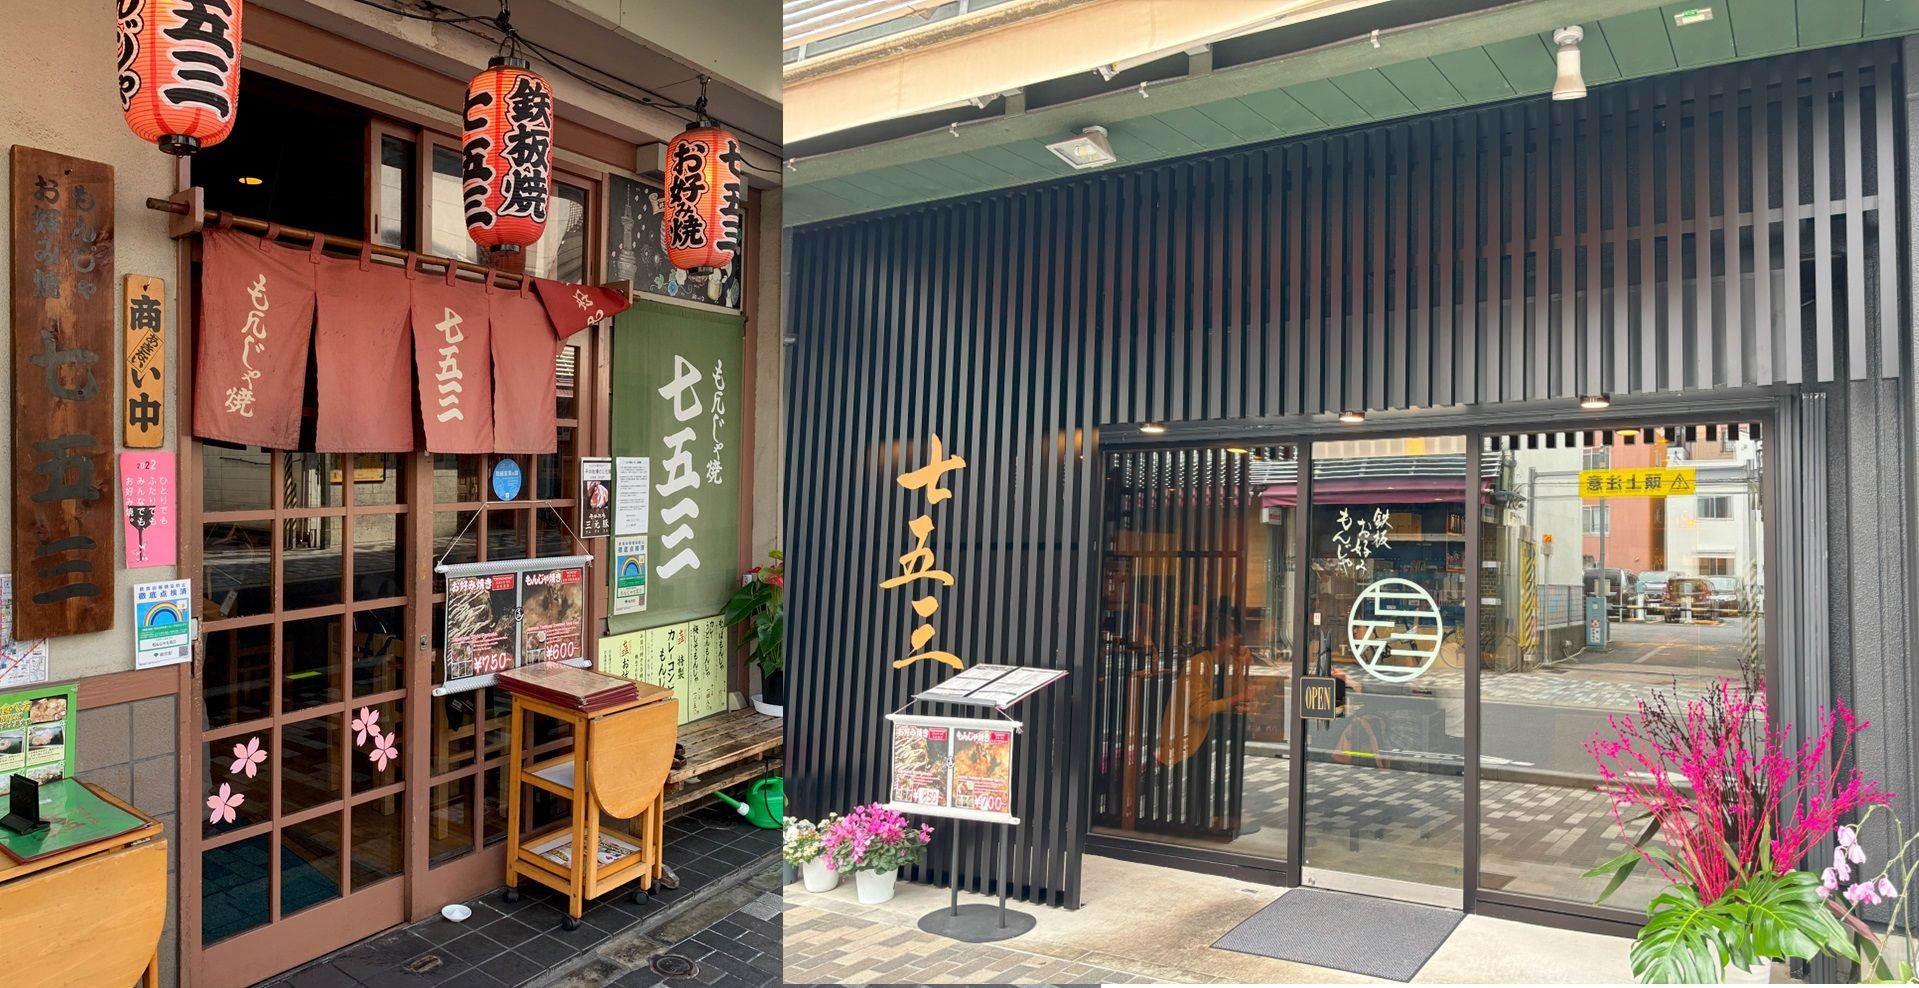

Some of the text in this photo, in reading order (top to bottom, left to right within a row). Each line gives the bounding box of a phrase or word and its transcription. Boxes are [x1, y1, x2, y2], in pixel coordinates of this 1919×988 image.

[502, 79, 549, 219] 鉄板焼
[669, 143, 705, 247] お好み焼
[718, 140, 740, 251] 七五三
[224, 273, 270, 418] もんじゃ焼
[434, 306, 465, 423] 七五三
[706, 359, 726, 485] もんじゃ焼
[30, 327, 99, 604] 七五三
[137, 459, 156, 470] 2022
[656, 354, 703, 580] 七五三
[159, 476, 169, 526] ひとりでも
[1373, 507, 1394, 549] 鉄板
[879, 432, 967, 671] 七五三
[1351, 518, 1373, 577] お好み
[138, 587, 187, 600] 徹底点検済
[451, 577, 493, 593] お好み焼き
[525, 572, 562, 586] もんじゃ焼き
[677, 654, 685, 680] 特製
[1305, 686, 1331, 710] OPEN
[956, 731, 991, 743] もんじゃ焼き
